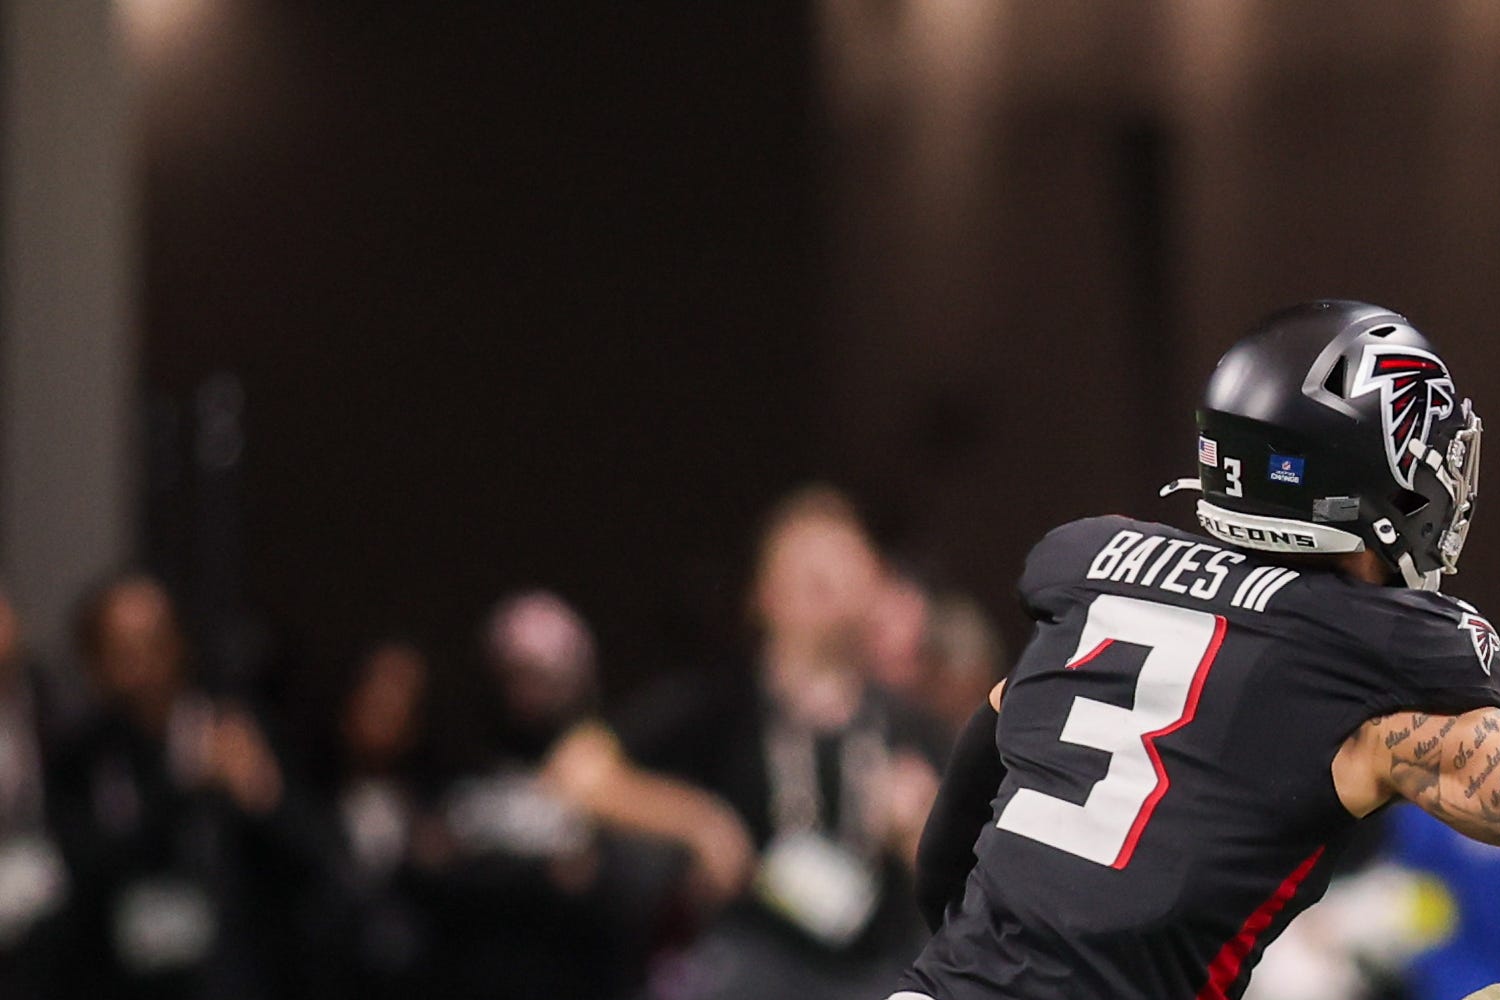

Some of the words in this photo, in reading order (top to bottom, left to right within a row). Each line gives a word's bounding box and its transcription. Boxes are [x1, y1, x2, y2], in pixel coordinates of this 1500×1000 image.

[1223, 456, 1243, 498] 3
[1199, 514, 1317, 549] FALCONS
[1086, 529, 1246, 600] BATES
[1230, 565, 1300, 612] III
[995, 593, 1228, 871] 3
